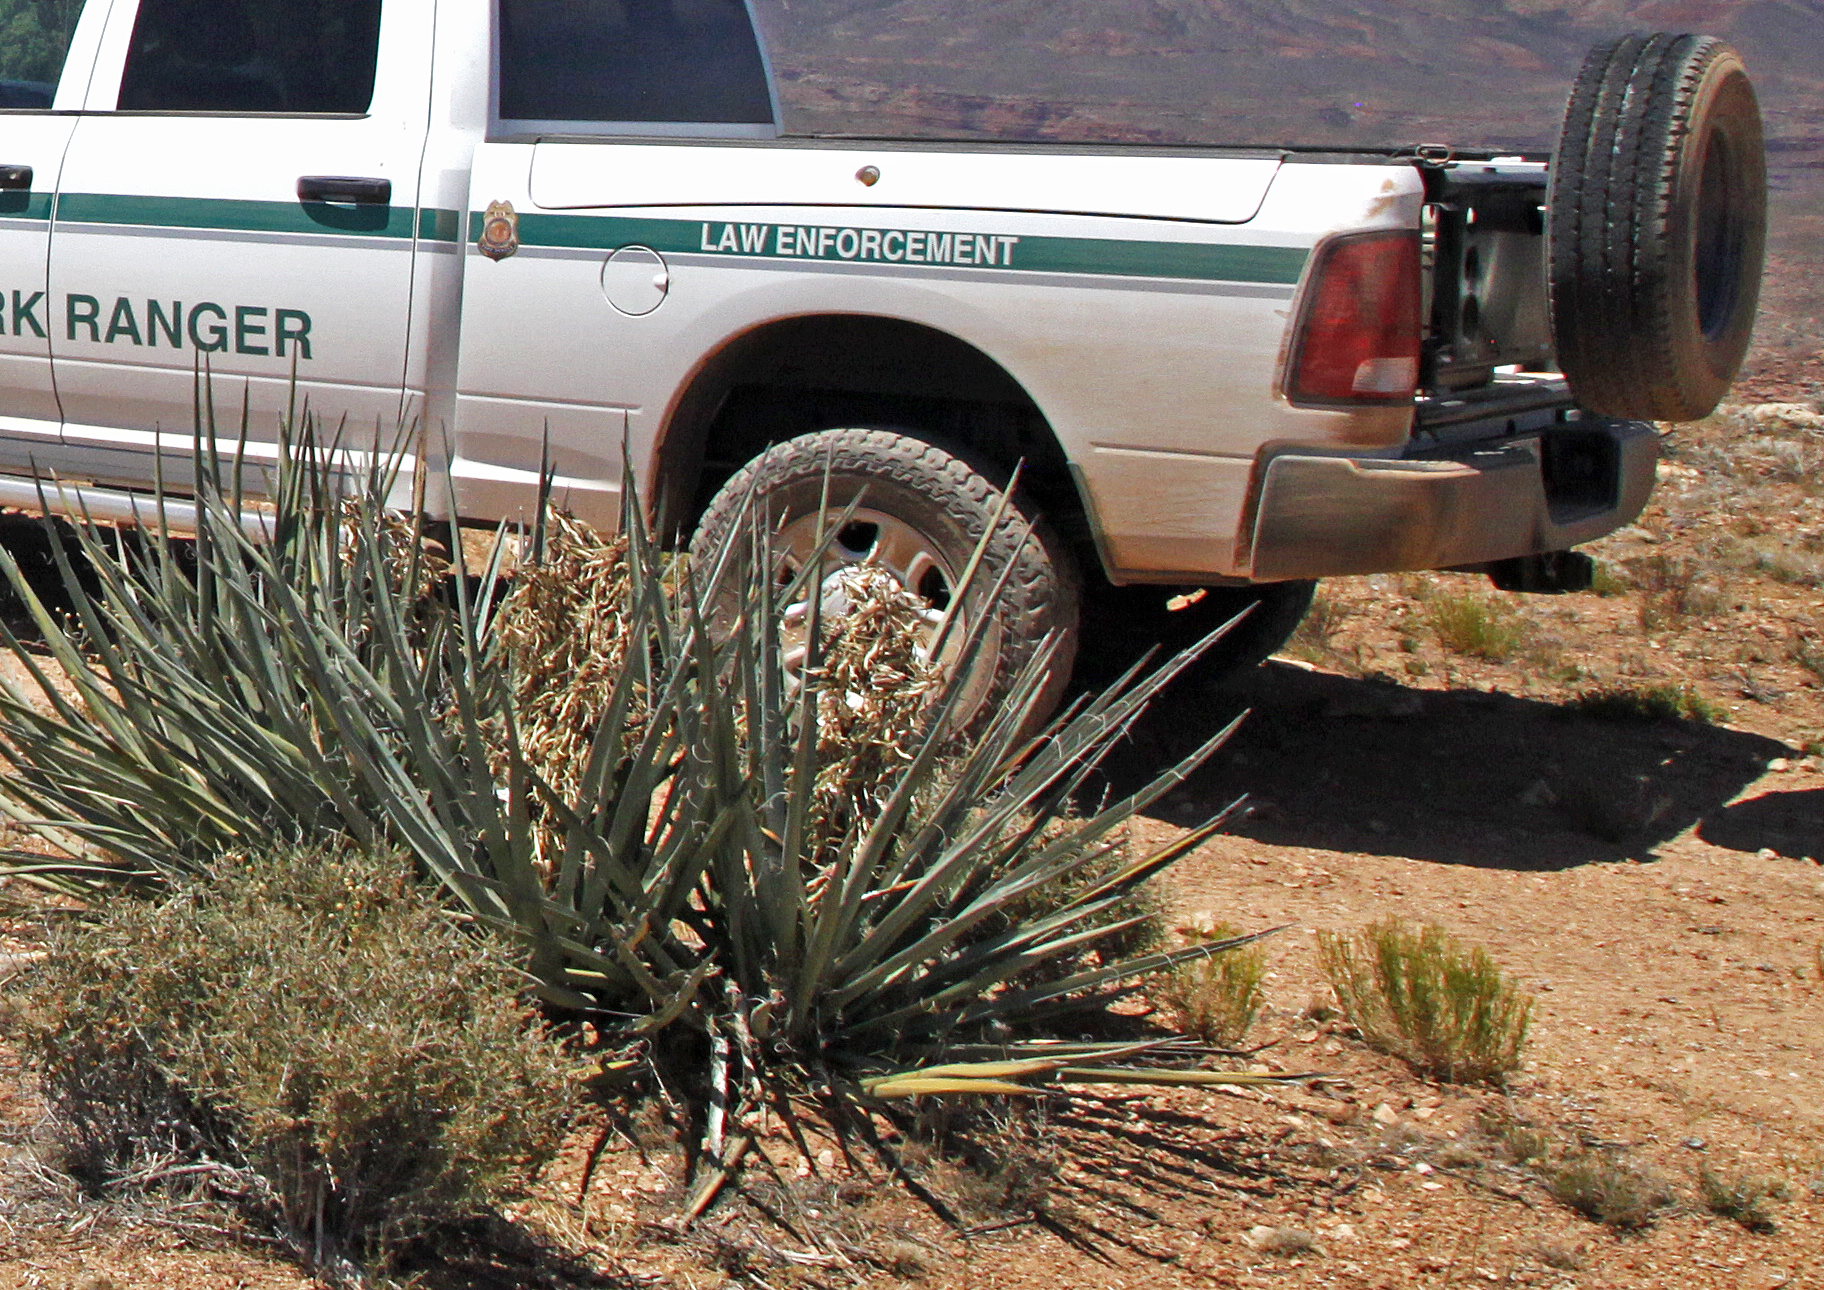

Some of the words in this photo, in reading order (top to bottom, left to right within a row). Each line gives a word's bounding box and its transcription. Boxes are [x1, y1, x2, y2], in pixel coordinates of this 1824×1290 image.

[700, 223, 768, 253] LAW
[775, 225, 1020, 265] ENFORCEMENT
[66, 293, 313, 360] RANGER
